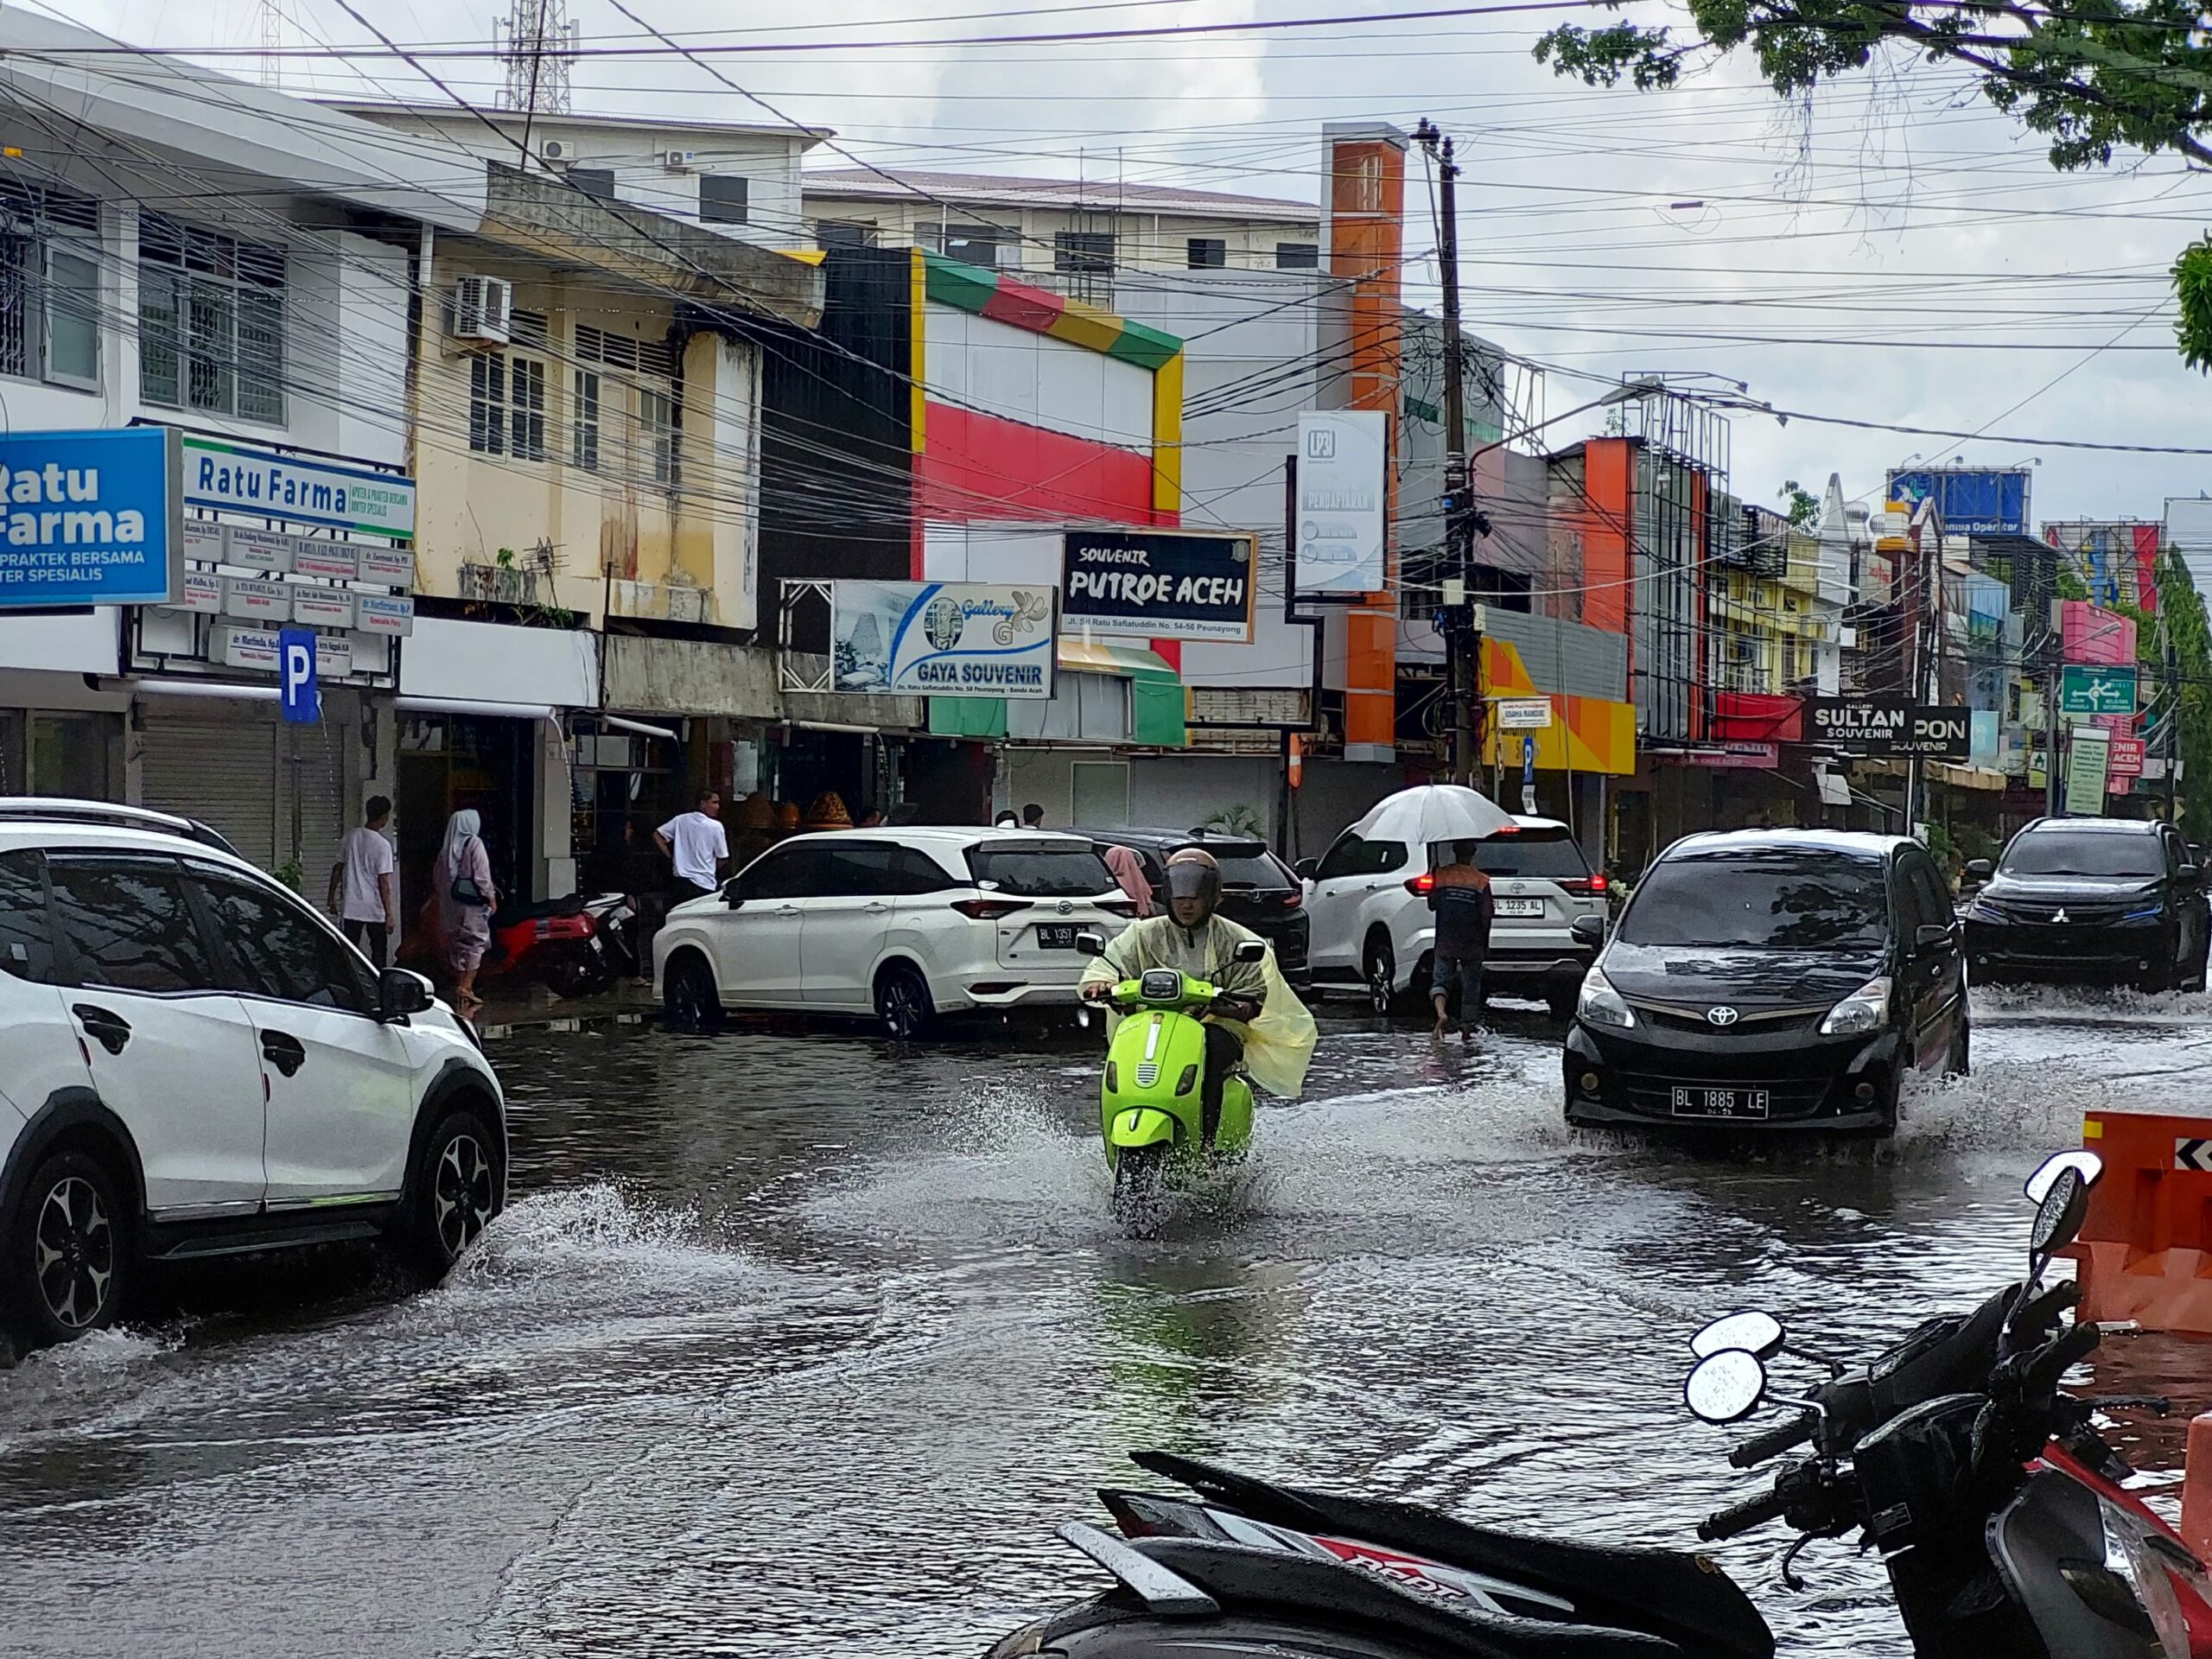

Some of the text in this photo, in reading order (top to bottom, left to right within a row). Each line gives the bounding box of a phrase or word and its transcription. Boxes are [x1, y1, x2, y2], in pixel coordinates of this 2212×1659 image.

[199, 456, 346, 513] Ratu Farma
[1944, 523, 1971, 531] emua
[71, 550, 145, 565] BERSAMA
[1078, 547, 1150, 567] SOUVENIR
[28, 568, 103, 582] SPESIALIS
[1070, 571, 1243, 606] PUTROE ACEH
[962, 599, 1014, 620] Gallery
[993, 620, 1014, 646] G
[1112, 620, 1156, 628] Safiatuddin
[1159, 621, 1172, 630] No.
[1173, 622, 1195, 631] 54-56
[1197, 623, 1242, 635] Peunayong
[288, 645, 310, 706] P
[918, 662, 1043, 684] GAYA SOUVENIR
[1815, 709, 1904, 728] SULTAN
[1827, 727, 1893, 739] SOUVENIR
[1524, 744, 1532, 775] P
[2113, 753, 2140, 763] ACEH
[1506, 900, 1527, 910] 1235
[1529, 900, 1541, 910] AL
[1040, 928, 1051, 940] BL
[1054, 928, 1072, 939] 1357
[1676, 1089, 1764, 1109] BL 1885 LE
